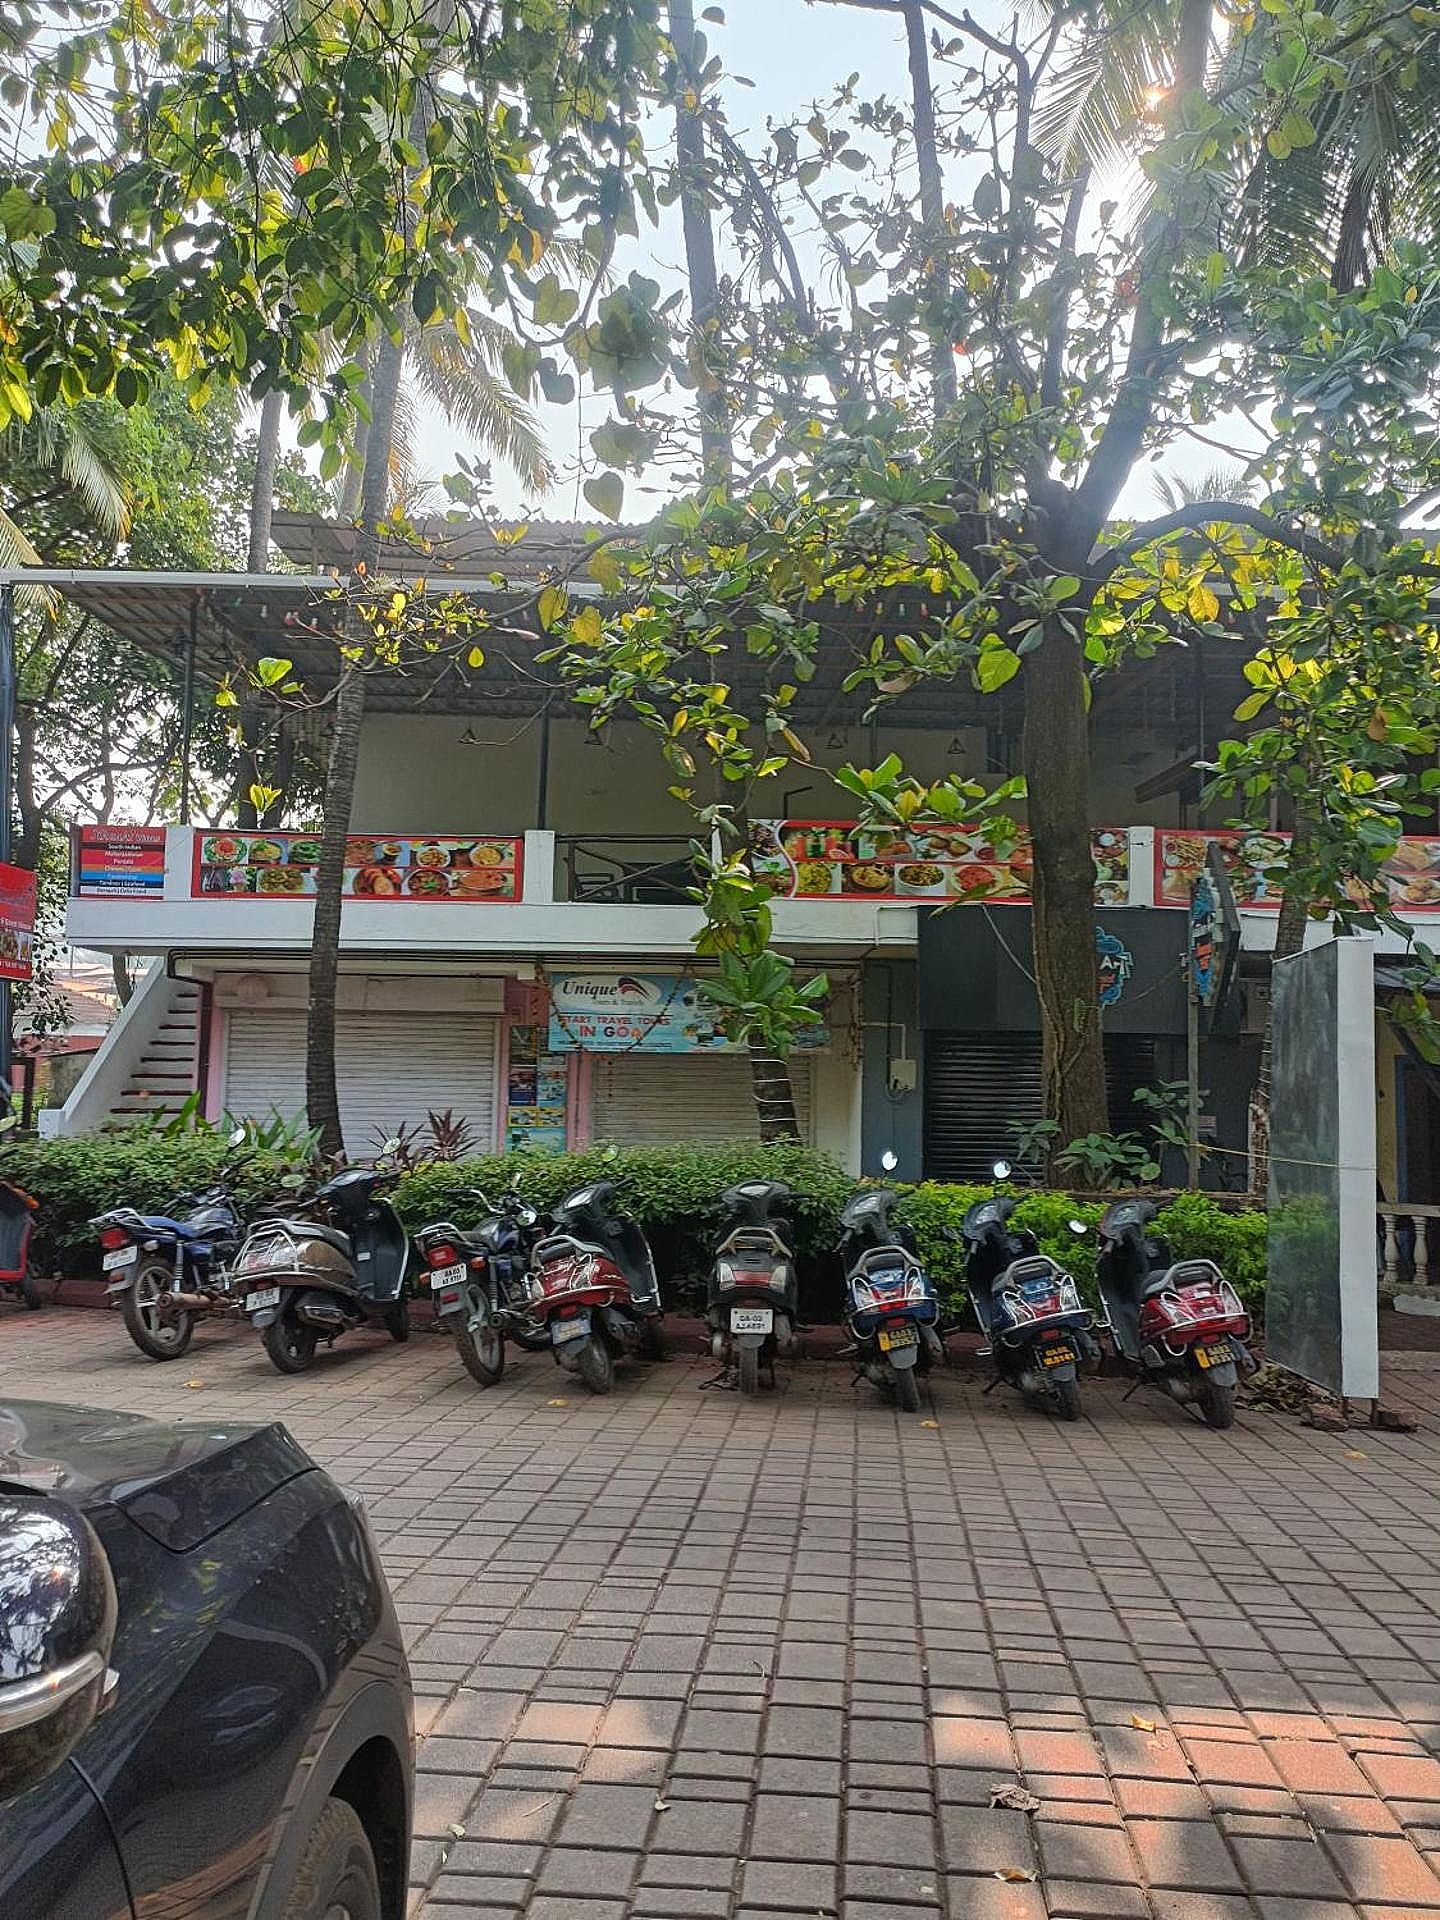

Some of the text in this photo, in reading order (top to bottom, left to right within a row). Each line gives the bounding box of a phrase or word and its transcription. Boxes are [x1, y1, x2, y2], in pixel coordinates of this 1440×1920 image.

[562, 981, 618, 1000] Unique
[597, 1016, 633, 1025] TRAVEL
[580, 1026, 597, 1037] IN
